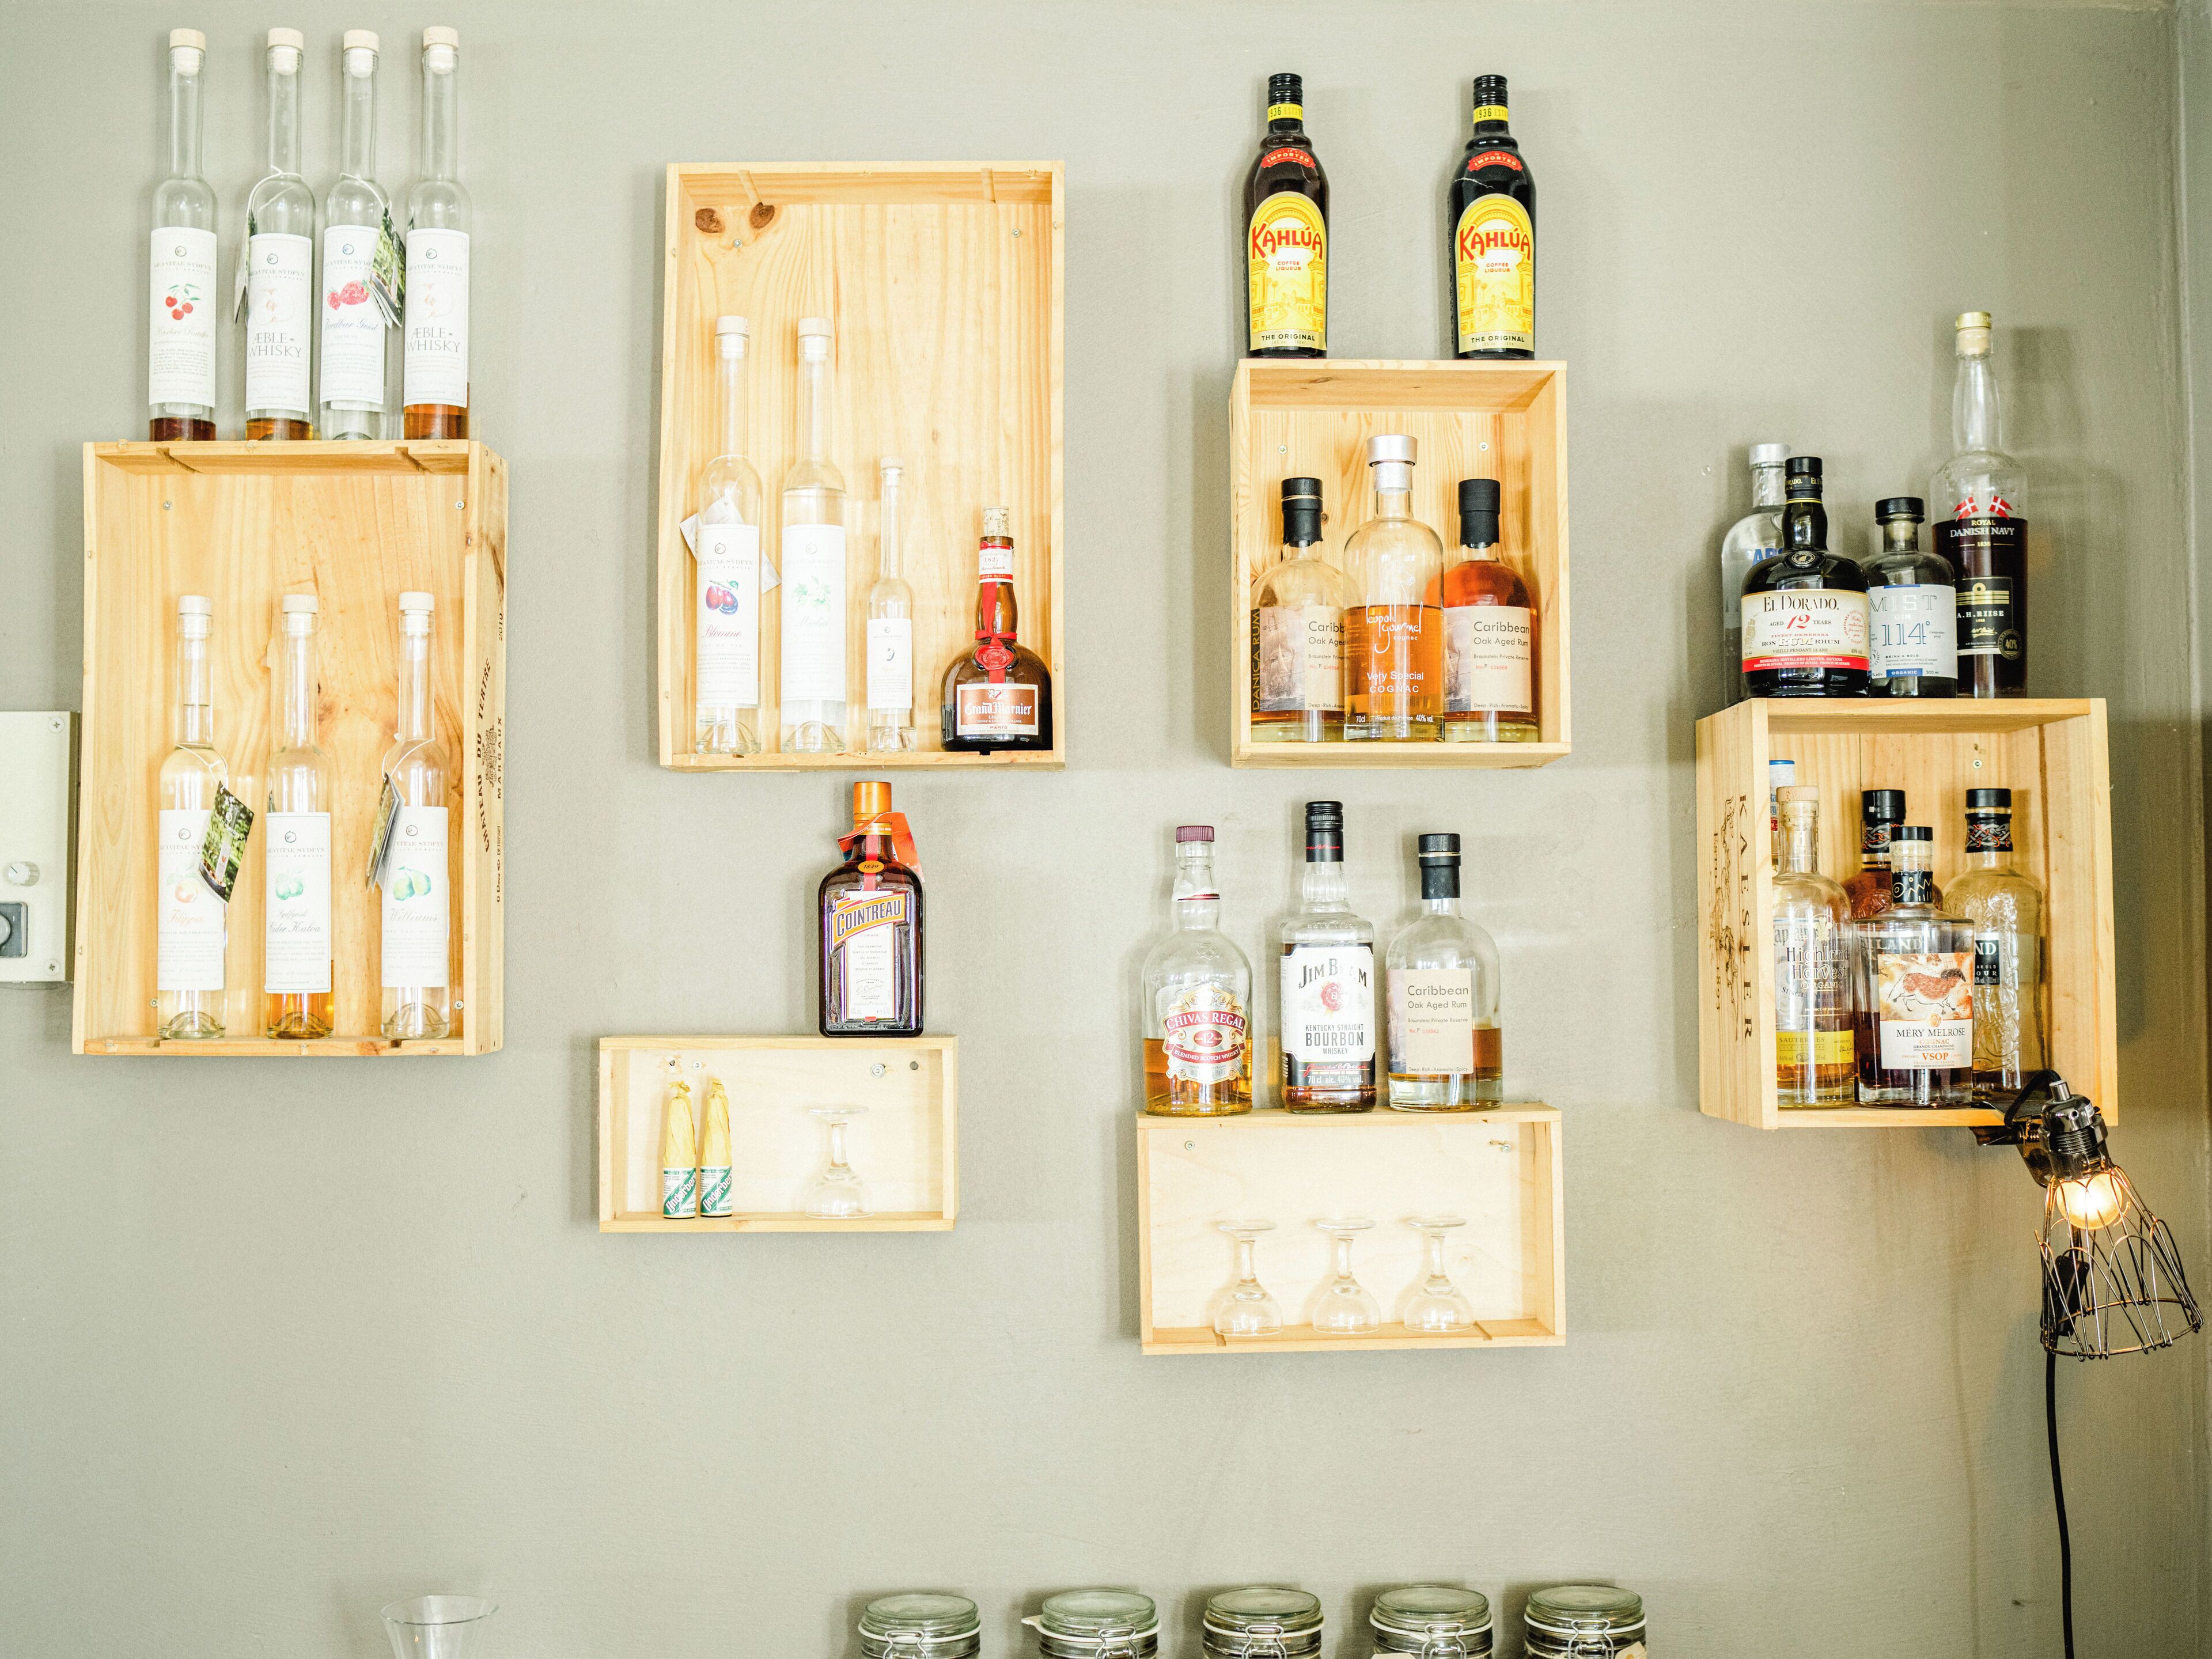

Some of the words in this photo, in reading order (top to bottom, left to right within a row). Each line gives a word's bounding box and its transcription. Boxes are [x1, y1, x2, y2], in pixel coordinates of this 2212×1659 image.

[1476, 108, 1492, 119] 1936
[1267, 153, 1309, 162] IMPORTED
[1475, 156, 1517, 166] IMPORTED
[1252, 223, 1323, 260] KAHLÚA
[1460, 225, 1531, 262] KAHLÚA
[357, 318, 379, 331] Geist
[248, 346, 302, 358] WHISKY
[406, 340, 461, 353] WHISKY
[1950, 527, 1990, 537] DANISH
[1991, 527, 2015, 535] NAVY
[1870, 595, 1937, 612] MIST
[1308, 621, 1344, 633] Caribb
[1786, 614, 1810, 629] 12
[703, 624, 741, 638] Blomme
[1474, 622, 1529, 634] Caribbean
[1308, 637, 1326, 645] Oak
[1495, 638, 1515, 646] Aged
[1517, 638, 1528, 646] Rum
[1779, 638, 1813, 646] RUM
[2005, 639, 2017, 650] 40%
[1367, 672, 1388, 682] Very
[1391, 671, 1424, 681] Special
[479, 657, 491, 719] TERTRE
[1370, 685, 1419, 693] COGNAC
[965, 702, 992, 715] Grand
[993, 702, 1032, 715] Marnier
[1356, 715, 1366, 724] 70cl
[477, 733, 482, 758] DU
[389, 908, 437, 922] Williams
[837, 900, 901, 937] COINTREAU
[1739, 795, 1752, 1039] KAESLER
[1774, 925, 1809, 945] aptain
[1787, 946, 1849, 965] Highland
[1298, 964, 1325, 989] JIM
[1328, 958, 1369, 990] BEAM
[1793, 964, 1848, 980] Harvest
[1408, 985, 1468, 995] Caribbean
[1801, 981, 1843, 990] ORGANIC
[1781, 986, 1808, 998] SINGL
[1426, 1001, 1448, 1010] Aged
[1166, 1013, 1209, 1029] CHIVAS
[1212, 1012, 1243, 1029] REGAL
[1203, 1032, 1214, 1044] 12
[1896, 1027, 1924, 1037] MÉRY
[1928, 1028, 1965, 1037] MELROSE
[1306, 1031, 1363, 1047] BOURBON
[1174, 1050, 1199, 1060] BLENDED
[1222, 1048, 1239, 1059] WHISKY
[1922, 1052, 1949, 1060] VSOP
[1325, 1075, 1336, 1084] alc.
[1338, 1075, 1351, 1083] 40%
[1353, 1075, 1363, 1083] vol.
